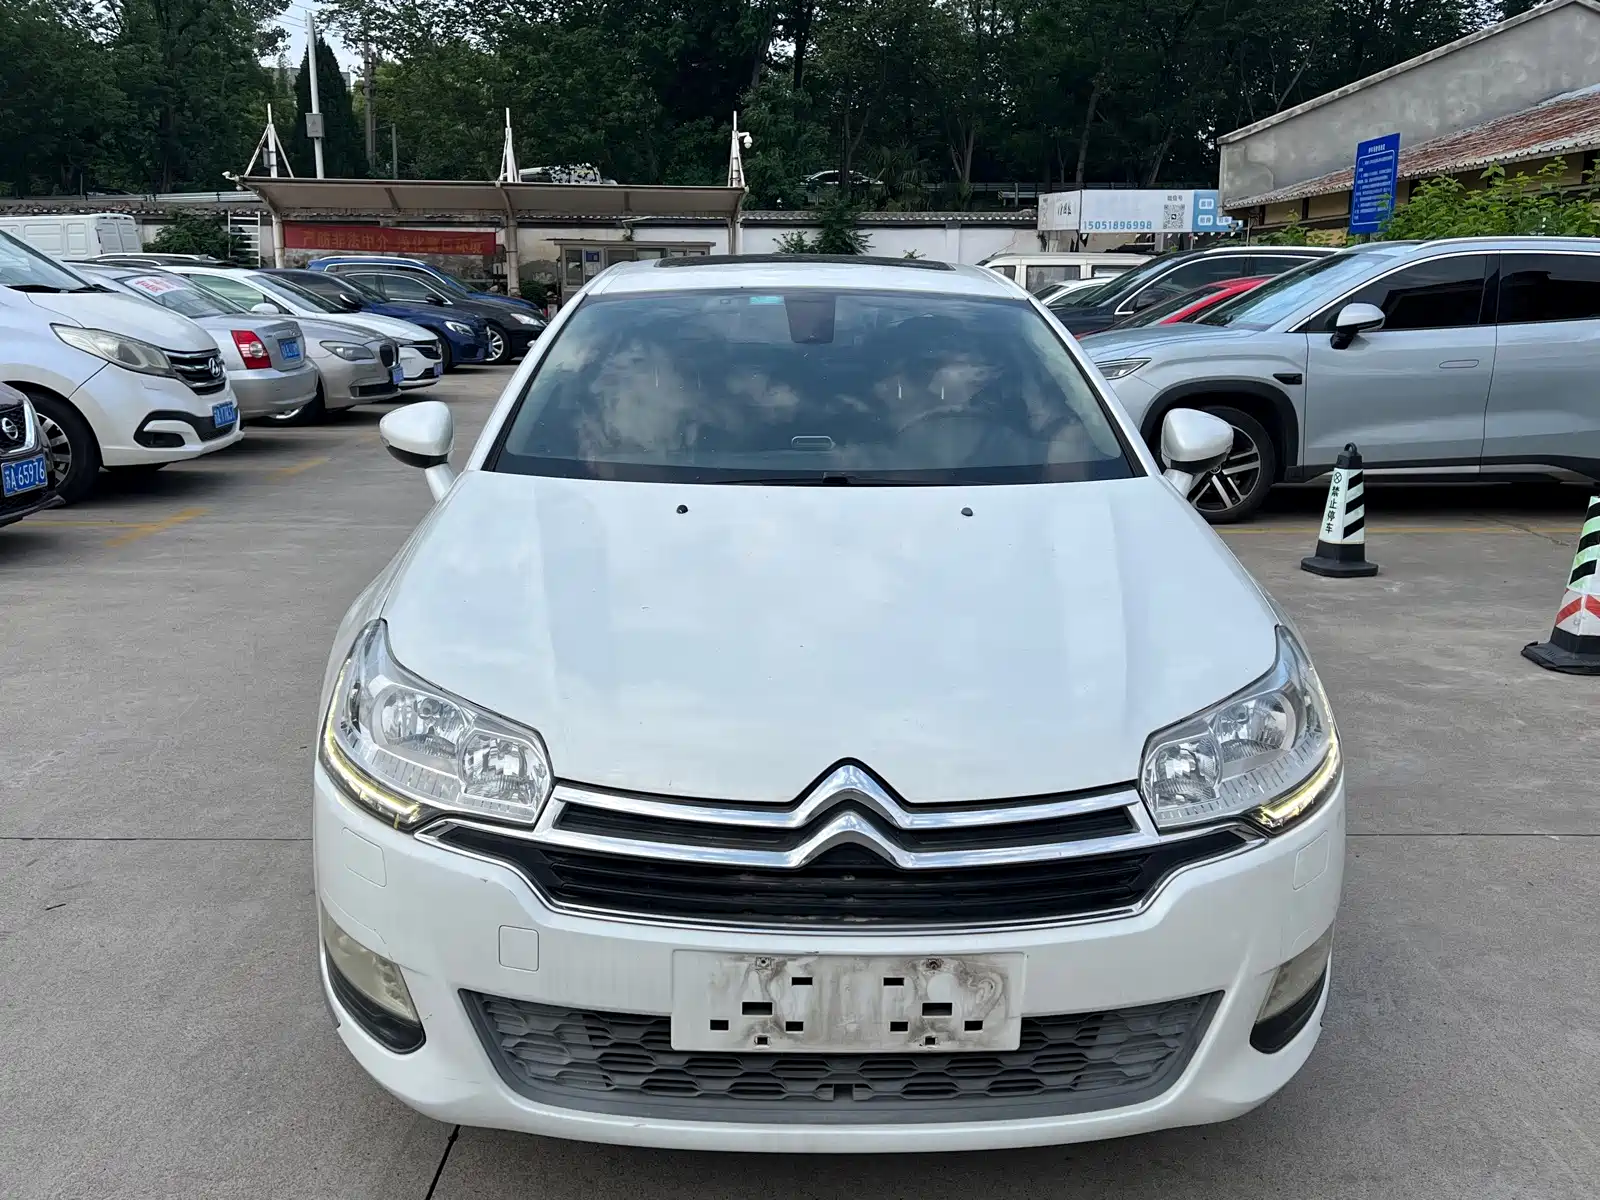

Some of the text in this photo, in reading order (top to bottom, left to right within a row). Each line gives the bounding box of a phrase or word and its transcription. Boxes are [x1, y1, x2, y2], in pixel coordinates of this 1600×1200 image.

[1083, 220, 1153, 230] 15051896998
[1325, 486, 1340, 534] 禁止停车
